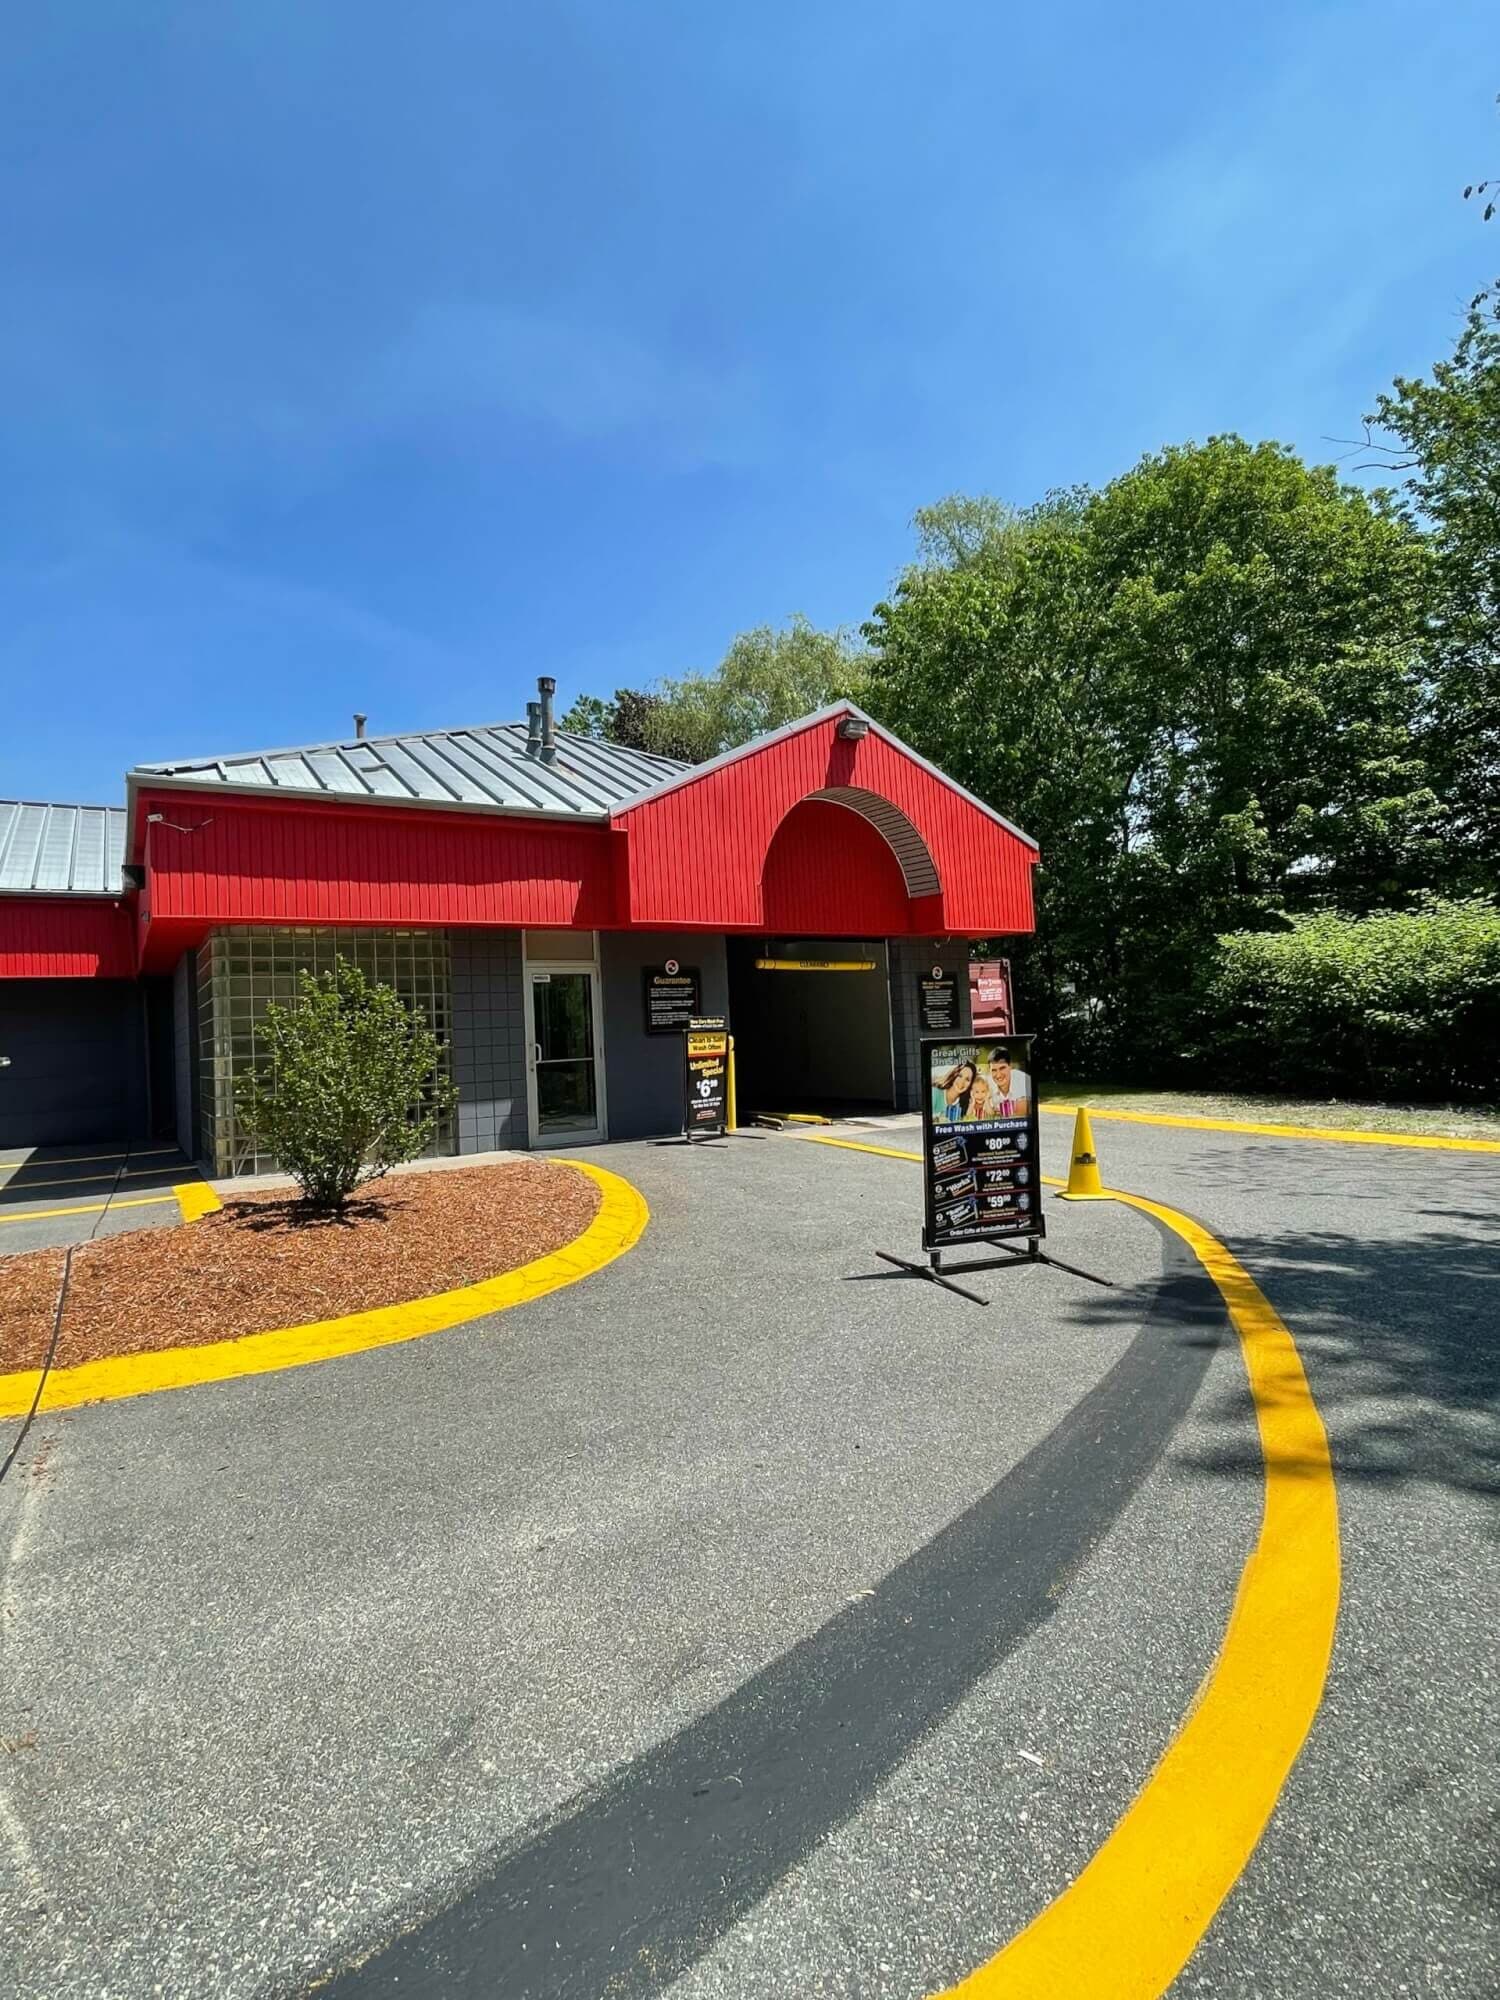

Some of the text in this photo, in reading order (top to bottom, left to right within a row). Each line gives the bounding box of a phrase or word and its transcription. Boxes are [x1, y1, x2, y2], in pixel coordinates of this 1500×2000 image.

[932, 1048, 980, 1057] Great Gifts
[948, 1057, 967, 1065] Sale
[935, 1121, 1027, 1134] Free Wash with Purchase
